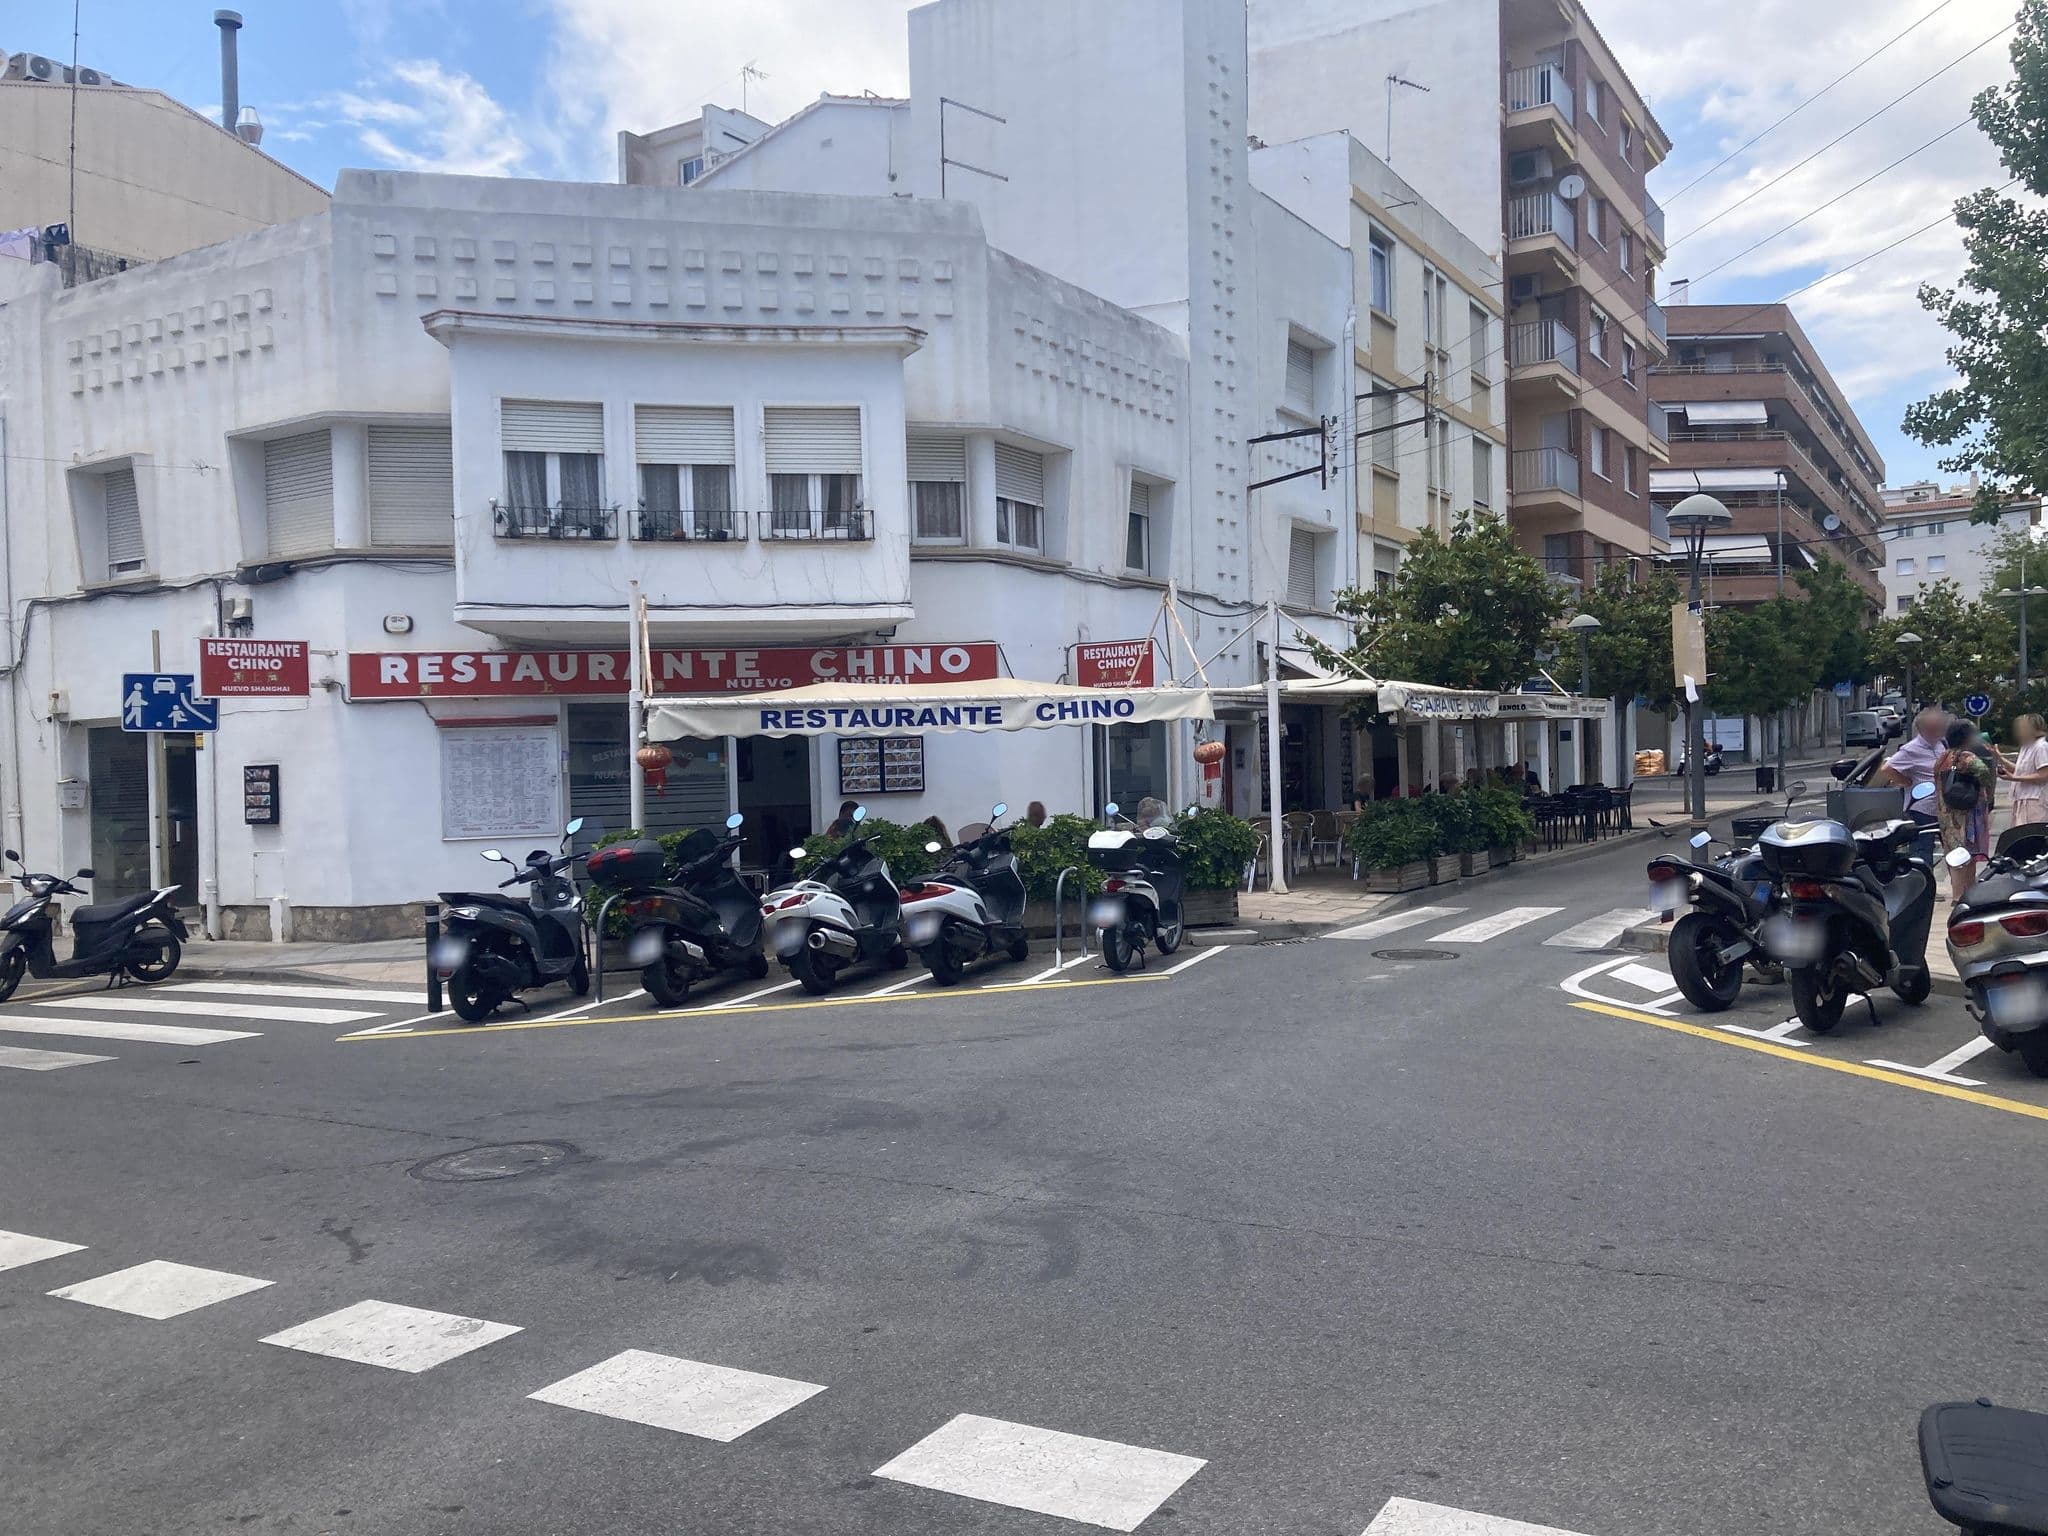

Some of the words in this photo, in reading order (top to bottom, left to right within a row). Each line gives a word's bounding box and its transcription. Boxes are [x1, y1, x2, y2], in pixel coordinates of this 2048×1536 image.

[207, 642, 301, 658] RESTAURANTE
[228, 657, 282, 670] CHINO
[810, 647, 971, 677] CHINO
[1097, 657, 1136, 670] CHINO
[726, 678, 793, 688] NUEVO
[760, 706, 1003, 730] RESTAURANTE
[1036, 699, 1135, 721] CHINO
